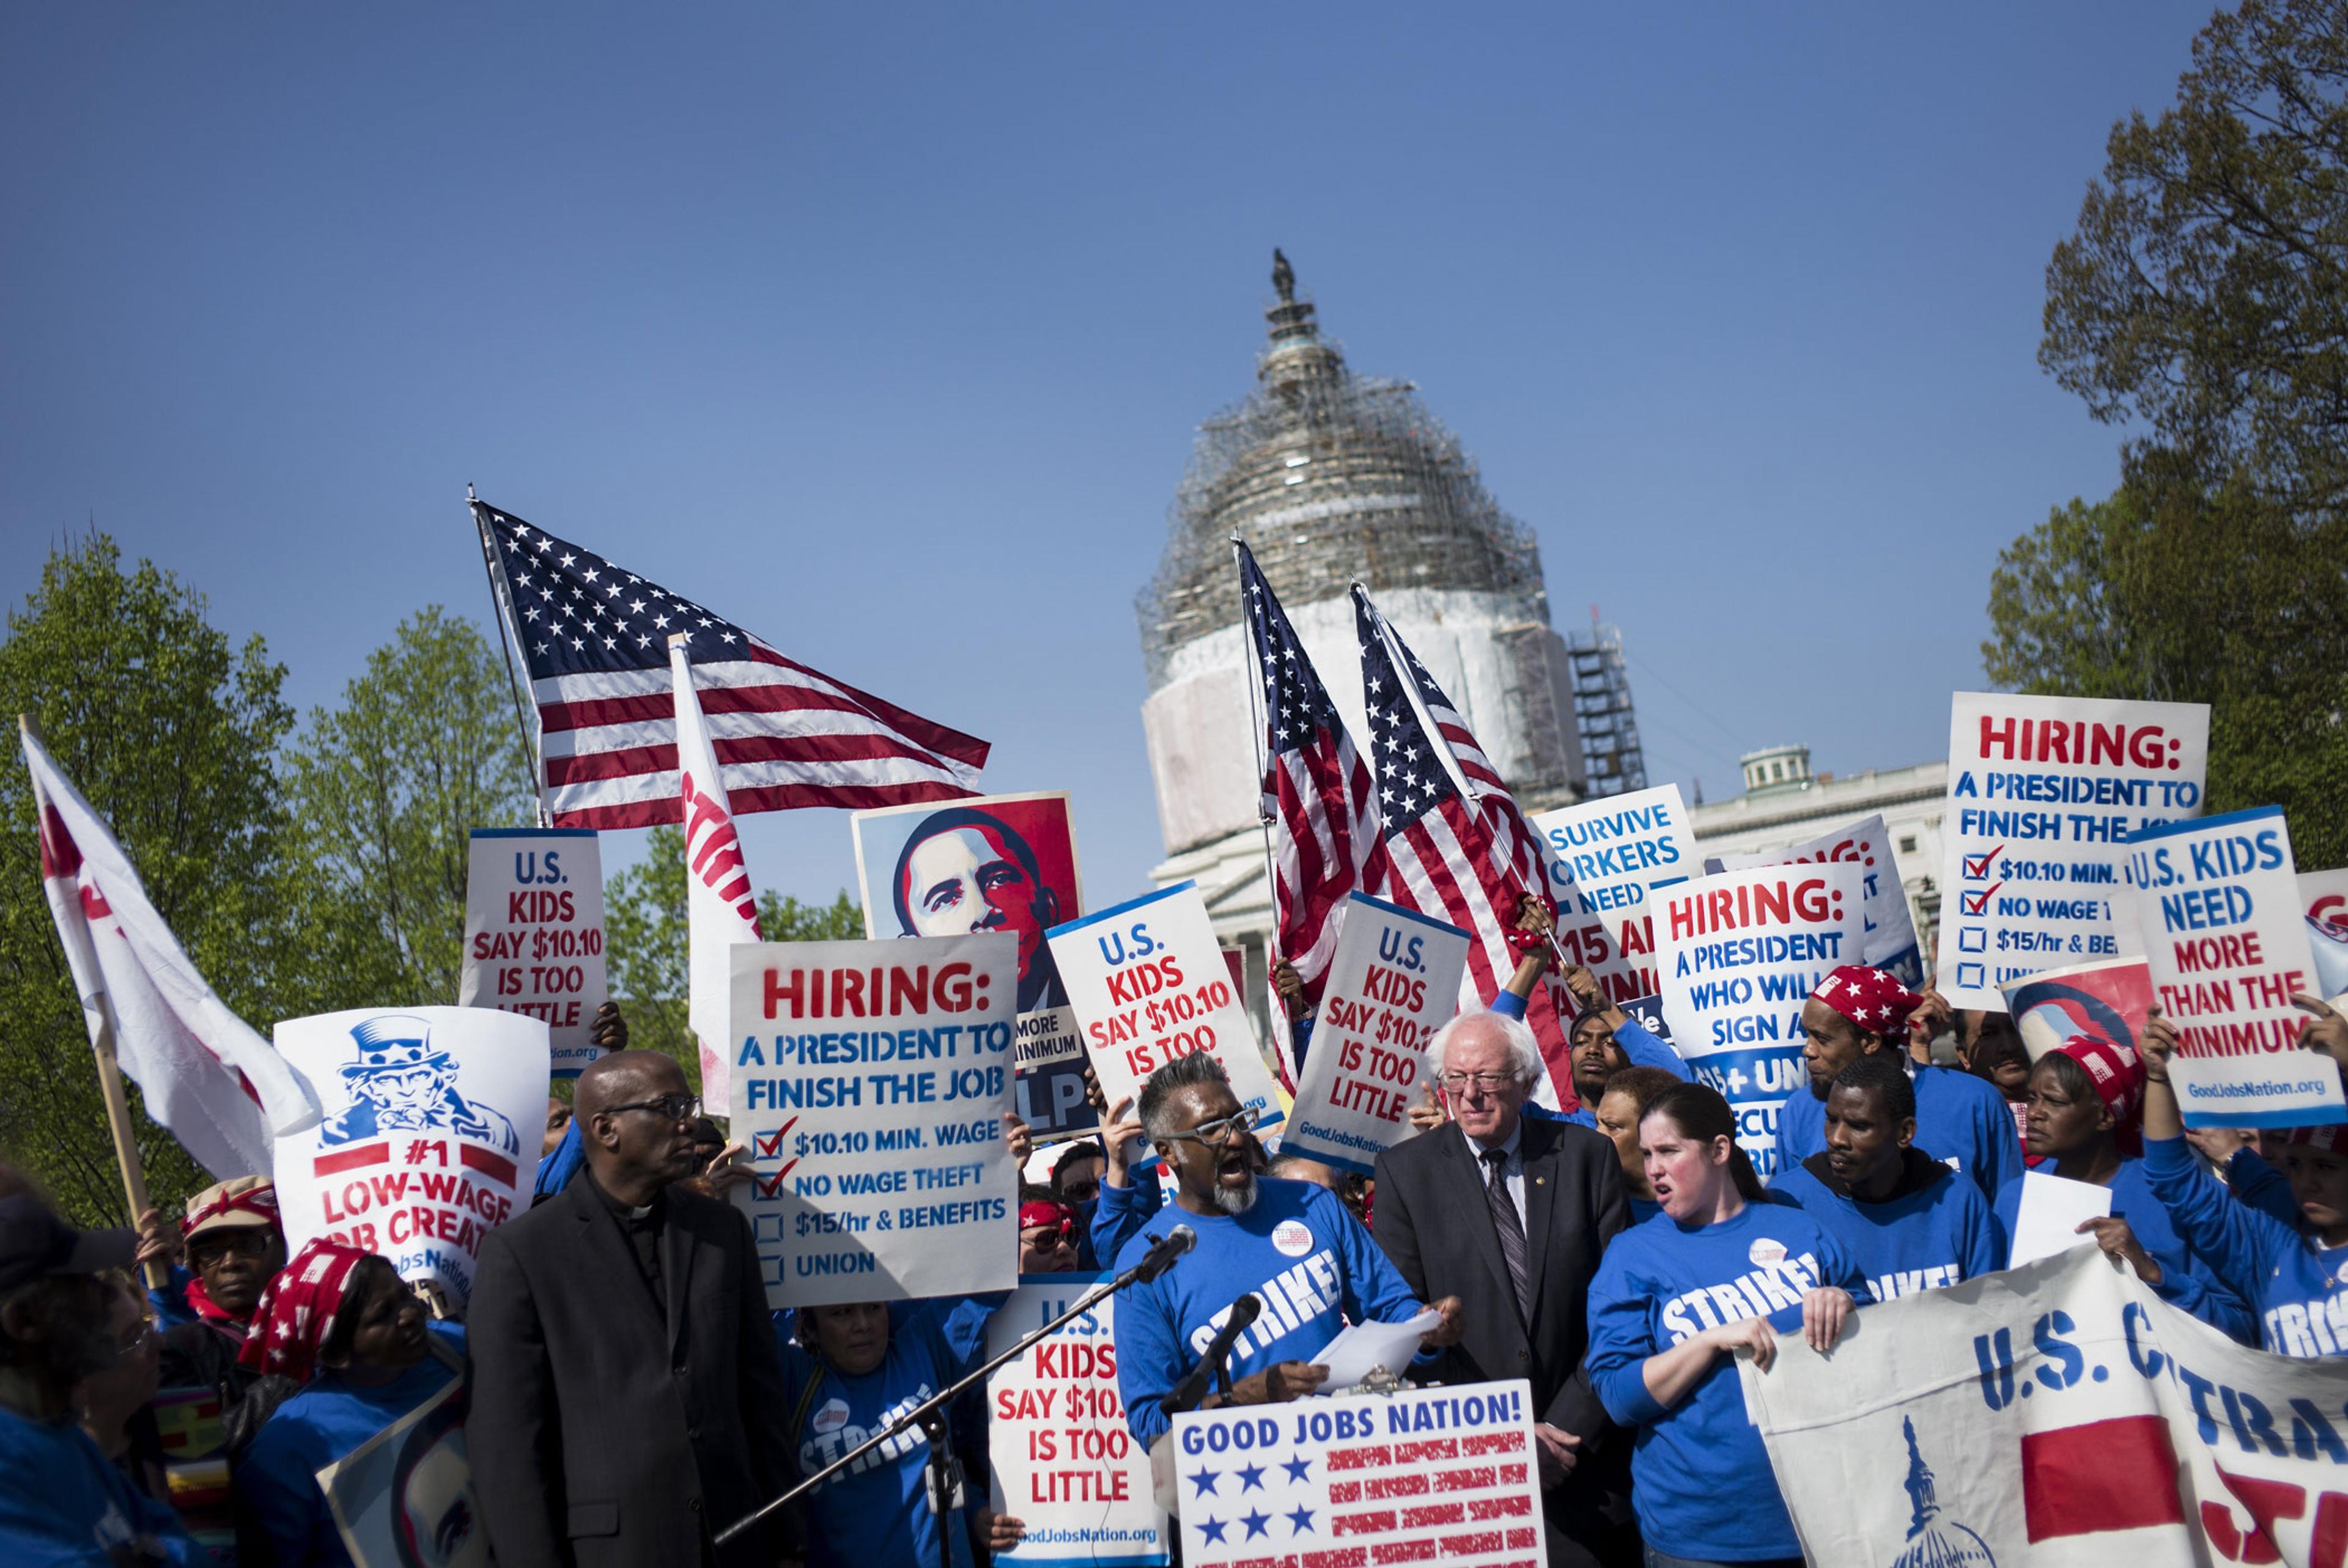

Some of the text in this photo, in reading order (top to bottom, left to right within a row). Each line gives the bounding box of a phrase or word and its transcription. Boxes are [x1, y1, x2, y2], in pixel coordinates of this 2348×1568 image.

[1979, 715, 2181, 770] HIRING:
[1954, 771, 2199, 808] A PRESIDENT TO
[1549, 804, 1671, 851] SURVIVE
[1961, 809, 2061, 841] FINISH
[2067, 814, 2128, 844] THE
[515, 852, 568, 884] U.S.
[1545, 836, 1680, 886] ORKERS
[1999, 858, 2065, 882] $10.10
[2070, 863, 2118, 884] MIN.
[2132, 848, 2185, 890] U.S.
[2190, 830, 2284, 882] KIDS
[509, 891, 575, 923] KIDS
[1577, 882, 1644, 915] NEED
[1669, 879, 1844, 941] HIRING:
[1998, 897, 2031, 917] NO
[2036, 899, 2098, 920] WAGE
[2160, 885, 2253, 933] NEED
[473, 927, 602, 961] SAY $10.10
[1098, 923, 1164, 966] U.S.
[1379, 927, 1426, 973] U.S.
[1677, 951, 1691, 978] A
[1695, 932, 1843, 973] PRESIDENT
[1996, 928, 2063, 951] $15/hr
[2069, 934, 2083, 953] &
[2173, 931, 2264, 974] MORE
[498, 965, 584, 995] IS TOO
[763, 962, 991, 1019] HIRING:
[1106, 955, 1184, 1007] KIDS
[1362, 964, 1427, 1013] KIDS
[1689, 977, 1752, 1012] WHO
[2159, 970, 2307, 1018] THAN THE
[1089, 981, 1230, 1050] SAY $10.10
[1326, 996, 1375, 1034] SAY
[1713, 1013, 1782, 1046] SIGN
[737, 1021, 1011, 1067] A PRESIDENT TO
[1016, 1034, 1076, 1061] INIMUM
[1125, 1045, 1154, 1076] IS
[1338, 1039, 1416, 1086] IS TOO
[748, 1066, 1005, 1110] FINISH THE JOB
[1329, 1077, 1408, 1123] LITTLE
[2188, 1080, 2326, 1099] GoodJobsNation.org
[404, 1139, 448, 1167] #1
[796, 1119, 999, 1157] $10.10 MIN. WAGE
[796, 1163, 984, 1197] NO WAGE THEFT
[796, 1198, 1006, 1237] $15/hr & BENEFITS
[797, 1252, 875, 1277] UNION
[1041, 1300, 1108, 1336] U.S.
[1035, 1344, 1117, 1379] KIDS
[1974, 1309, 2110, 1412] U.S.
[997, 1389, 1057, 1420] SAY
[1182, 1390, 1522, 1456] GOOD JOBS NATION!
[1029, 1429, 1128, 1460] IS TOO
[1032, 1471, 1129, 1503] LITTLE
